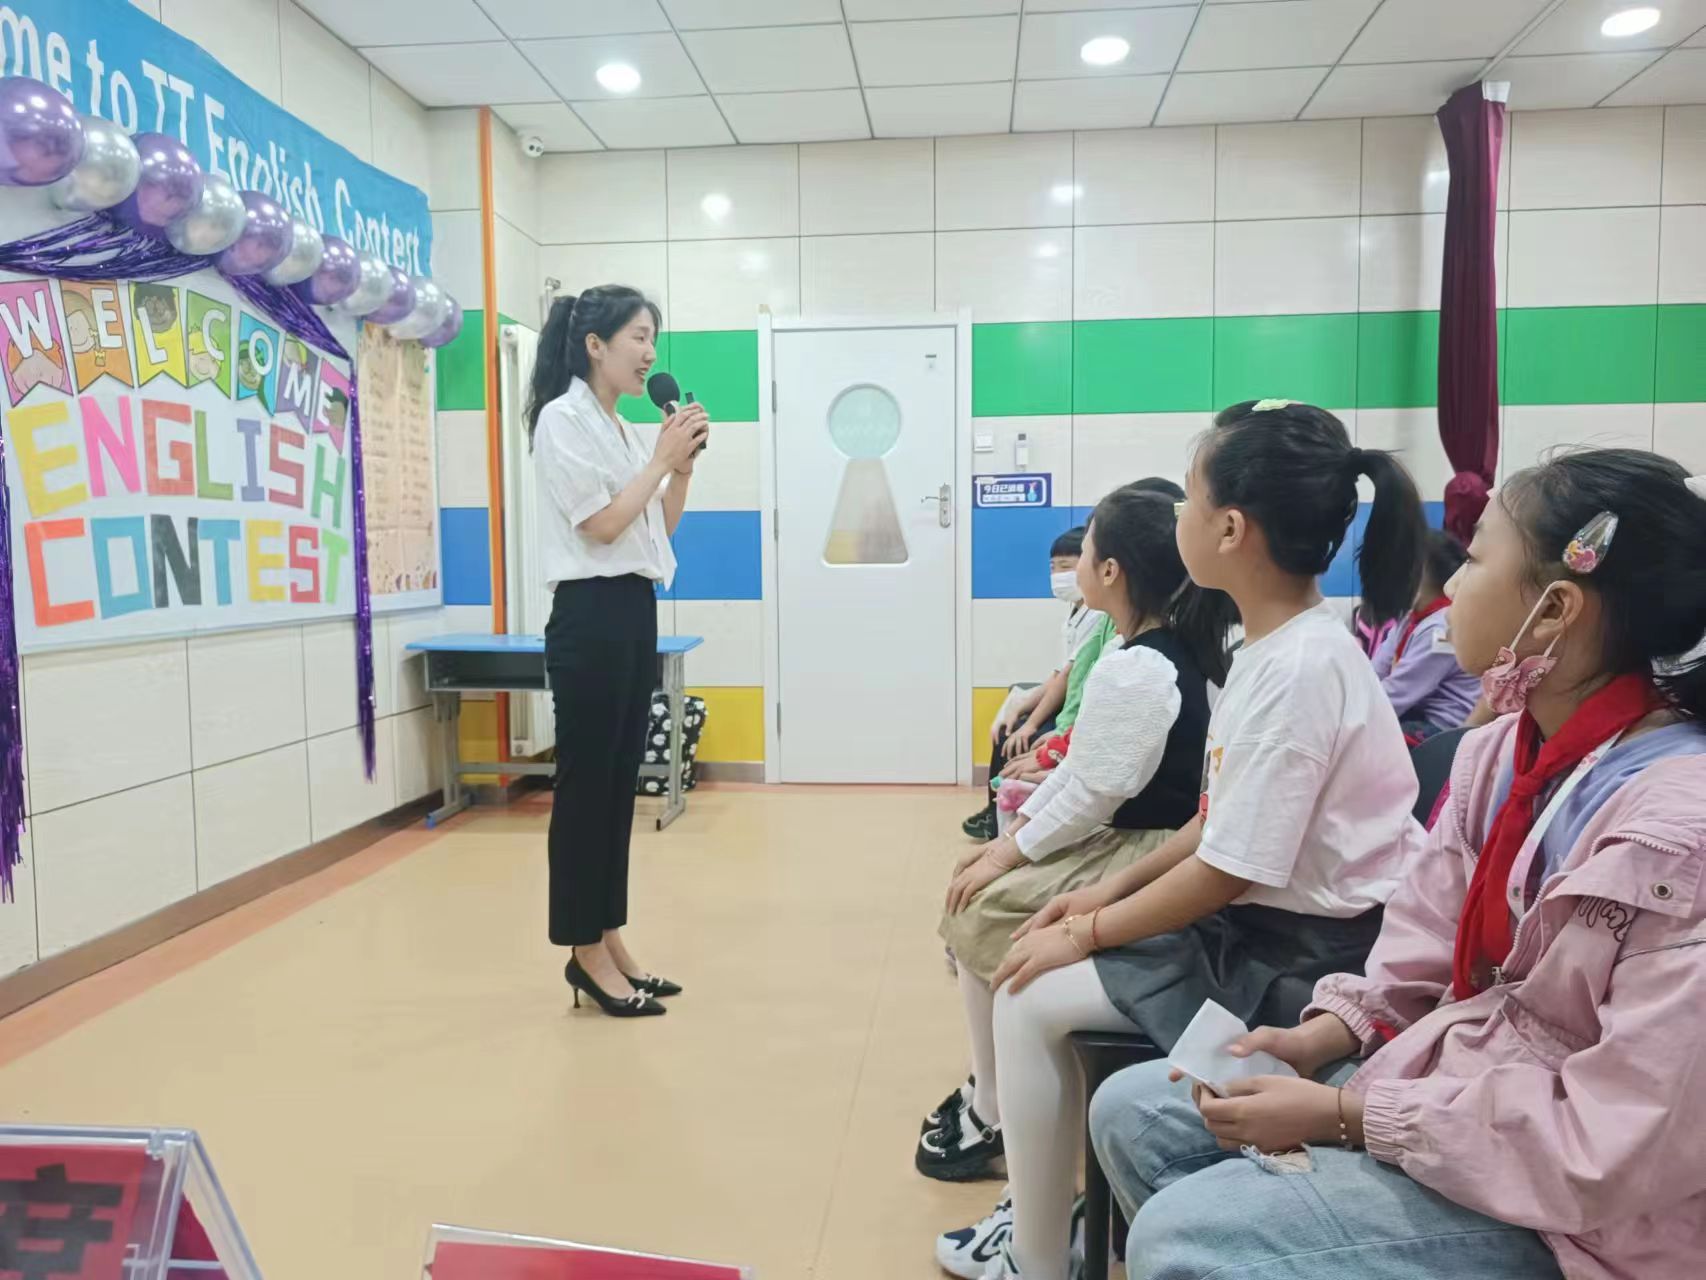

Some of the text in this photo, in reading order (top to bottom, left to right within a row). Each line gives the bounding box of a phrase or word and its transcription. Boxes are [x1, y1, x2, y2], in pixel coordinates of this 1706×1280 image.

[86, 39, 138, 137] to
[141, 59, 195, 147] TT
[335, 178, 424, 277] Contest
[1, 288, 335, 427] WELCOME
[7, 395, 346, 529] ENGLISH
[24, 513, 349, 627] CONTEST
